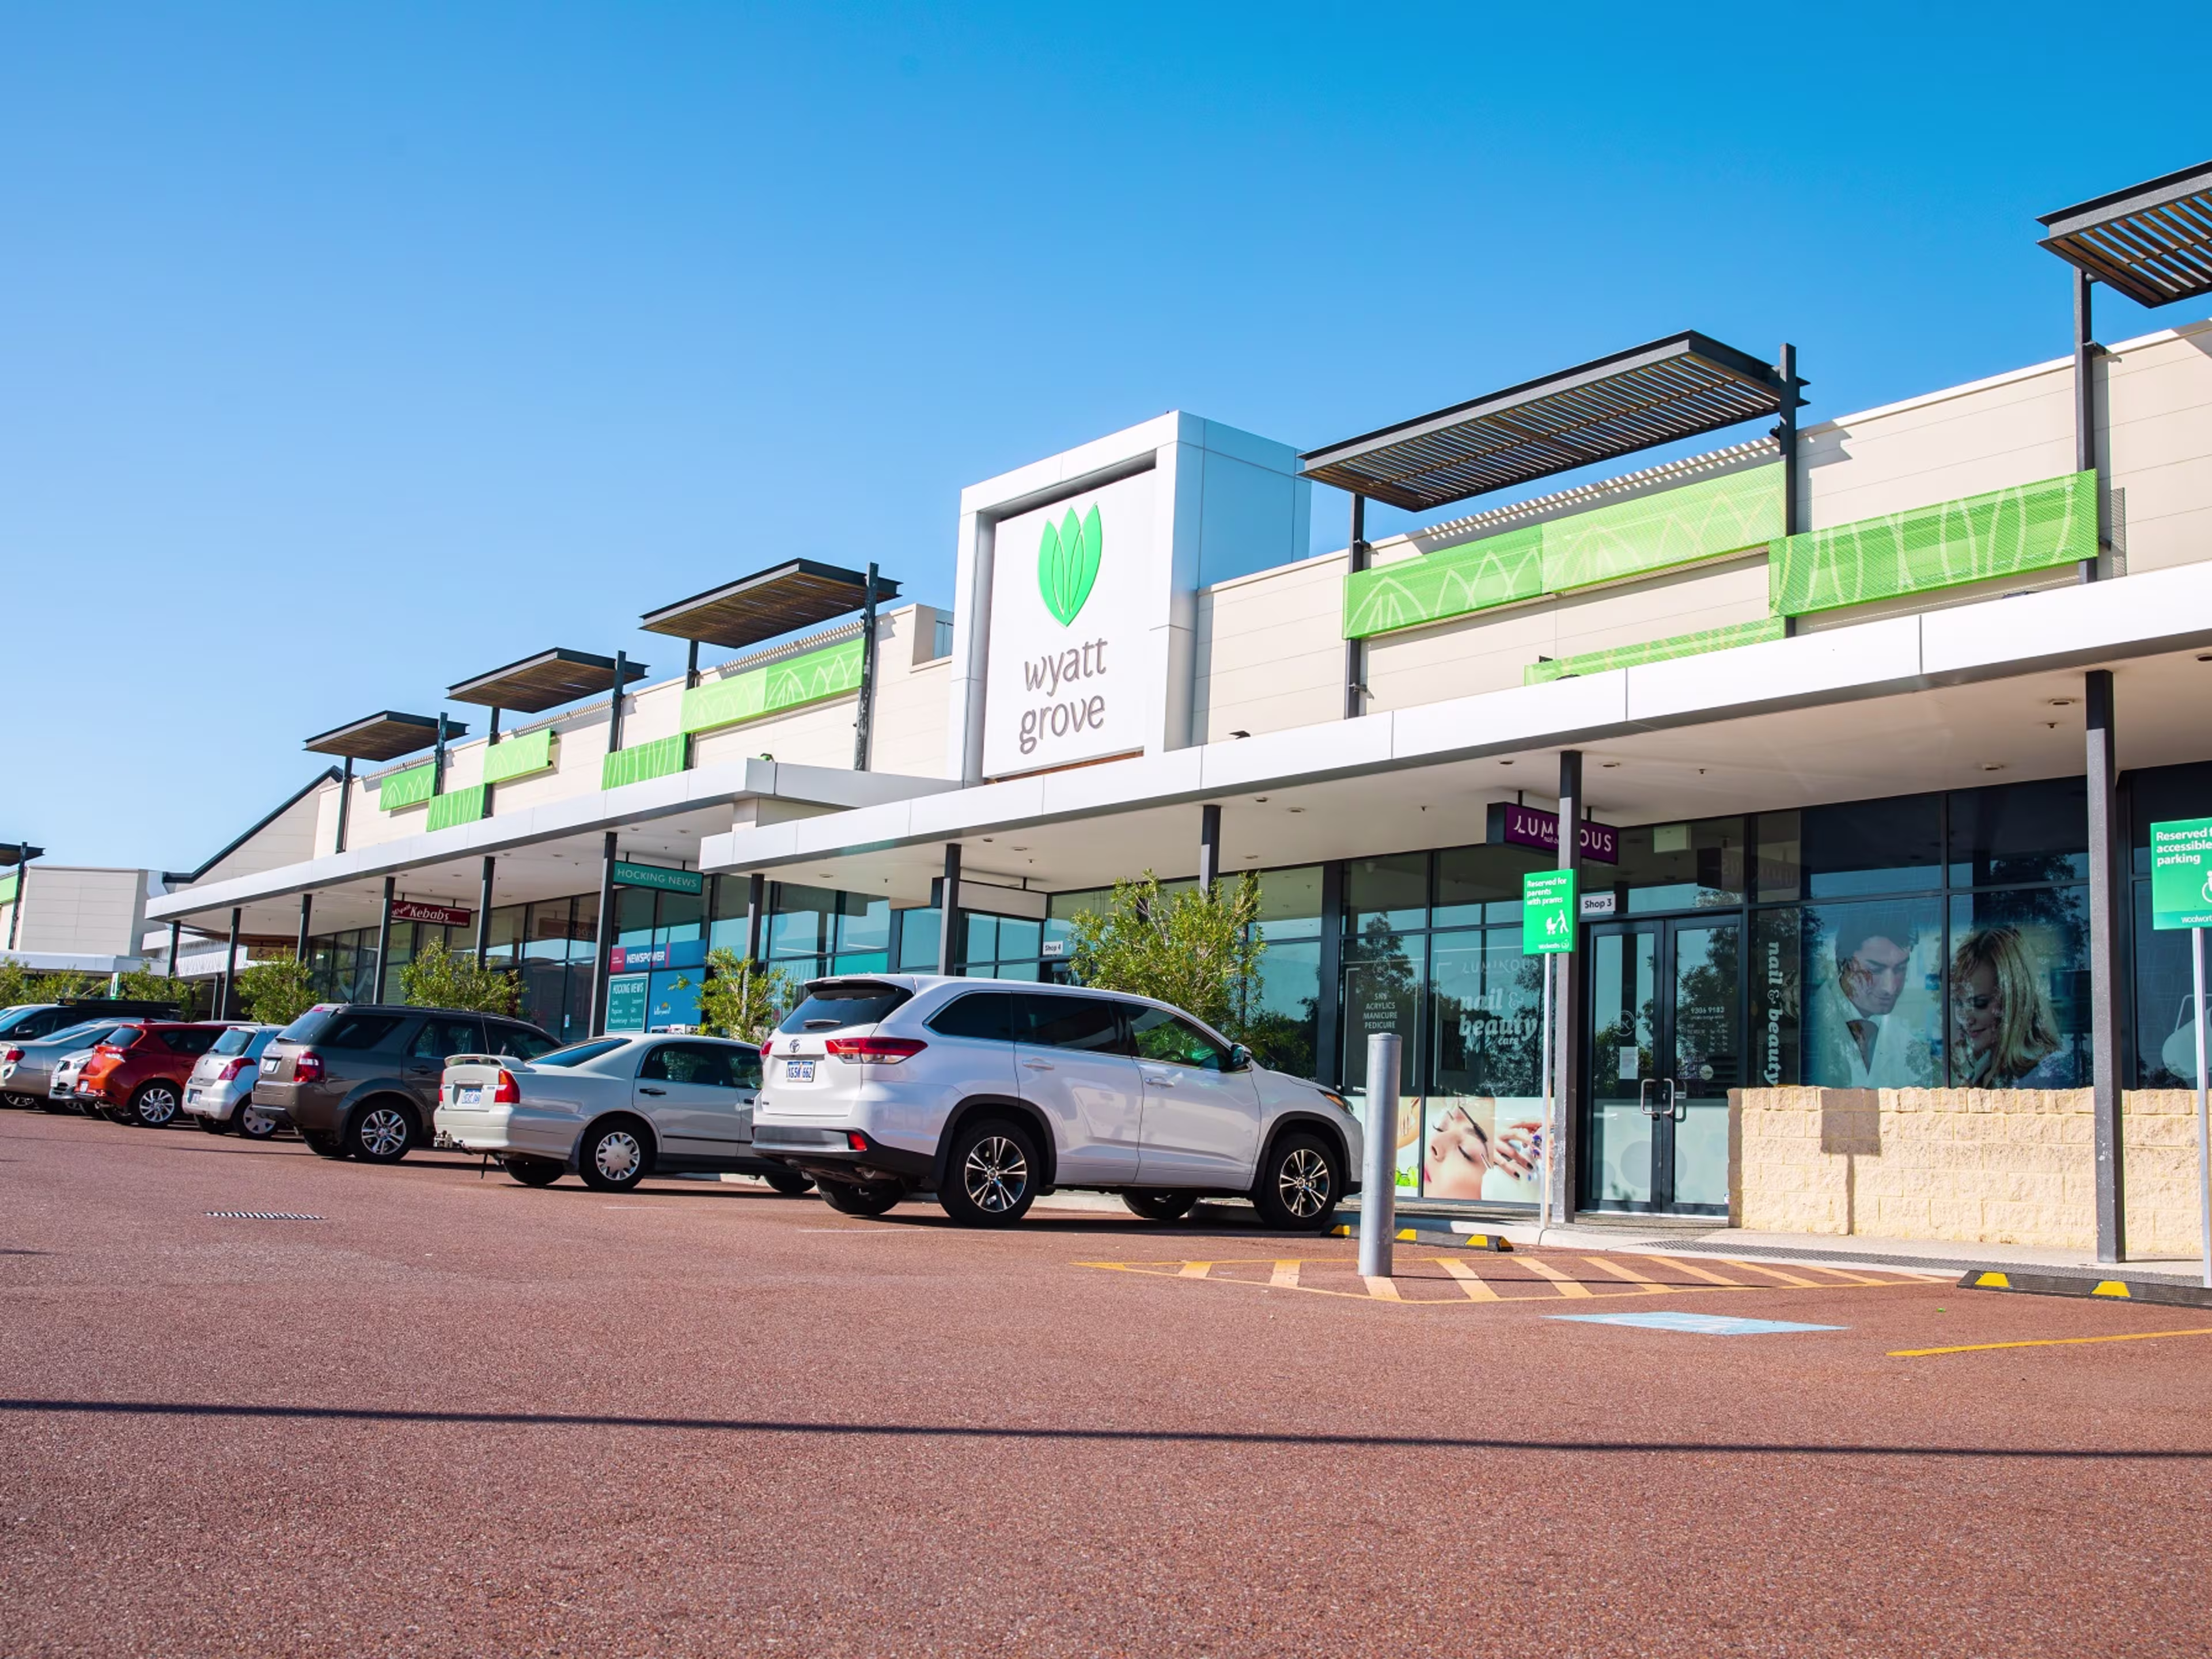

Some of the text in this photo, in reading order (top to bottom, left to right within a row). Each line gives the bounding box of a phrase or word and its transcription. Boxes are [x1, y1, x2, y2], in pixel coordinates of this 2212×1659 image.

[1024, 638, 1108, 697] wyatt
[1019, 695, 1105, 755] grove
[1514, 815, 1612, 852] LUMOUS
[2156, 827, 2207, 841] Reserved
[2156, 839, 2212, 853] accessible
[2157, 853, 2201, 868] parking
[618, 868, 697, 887] HOCKING NEWS
[1527, 877, 1567, 888] Reserved for
[1527, 888, 1552, 899] parents
[1542, 897, 1563, 907] prams
[1585, 898, 1612, 909] Shop 3
[410, 906, 450, 921] Kebabs
[627, 951, 665, 964] NEWSPOWER
[1365, 1002, 1395, 1010] ACRYLICS
[1460, 987, 1524, 1012] nail &
[1362, 1012, 1398, 1020] MANICURE
[1763, 941, 1783, 1086] nail & beauty
[1364, 1021, 1396, 1029] PEDICURE
[1459, 1014, 1538, 1041] beauty
[1498, 1036, 1519, 1046] care
